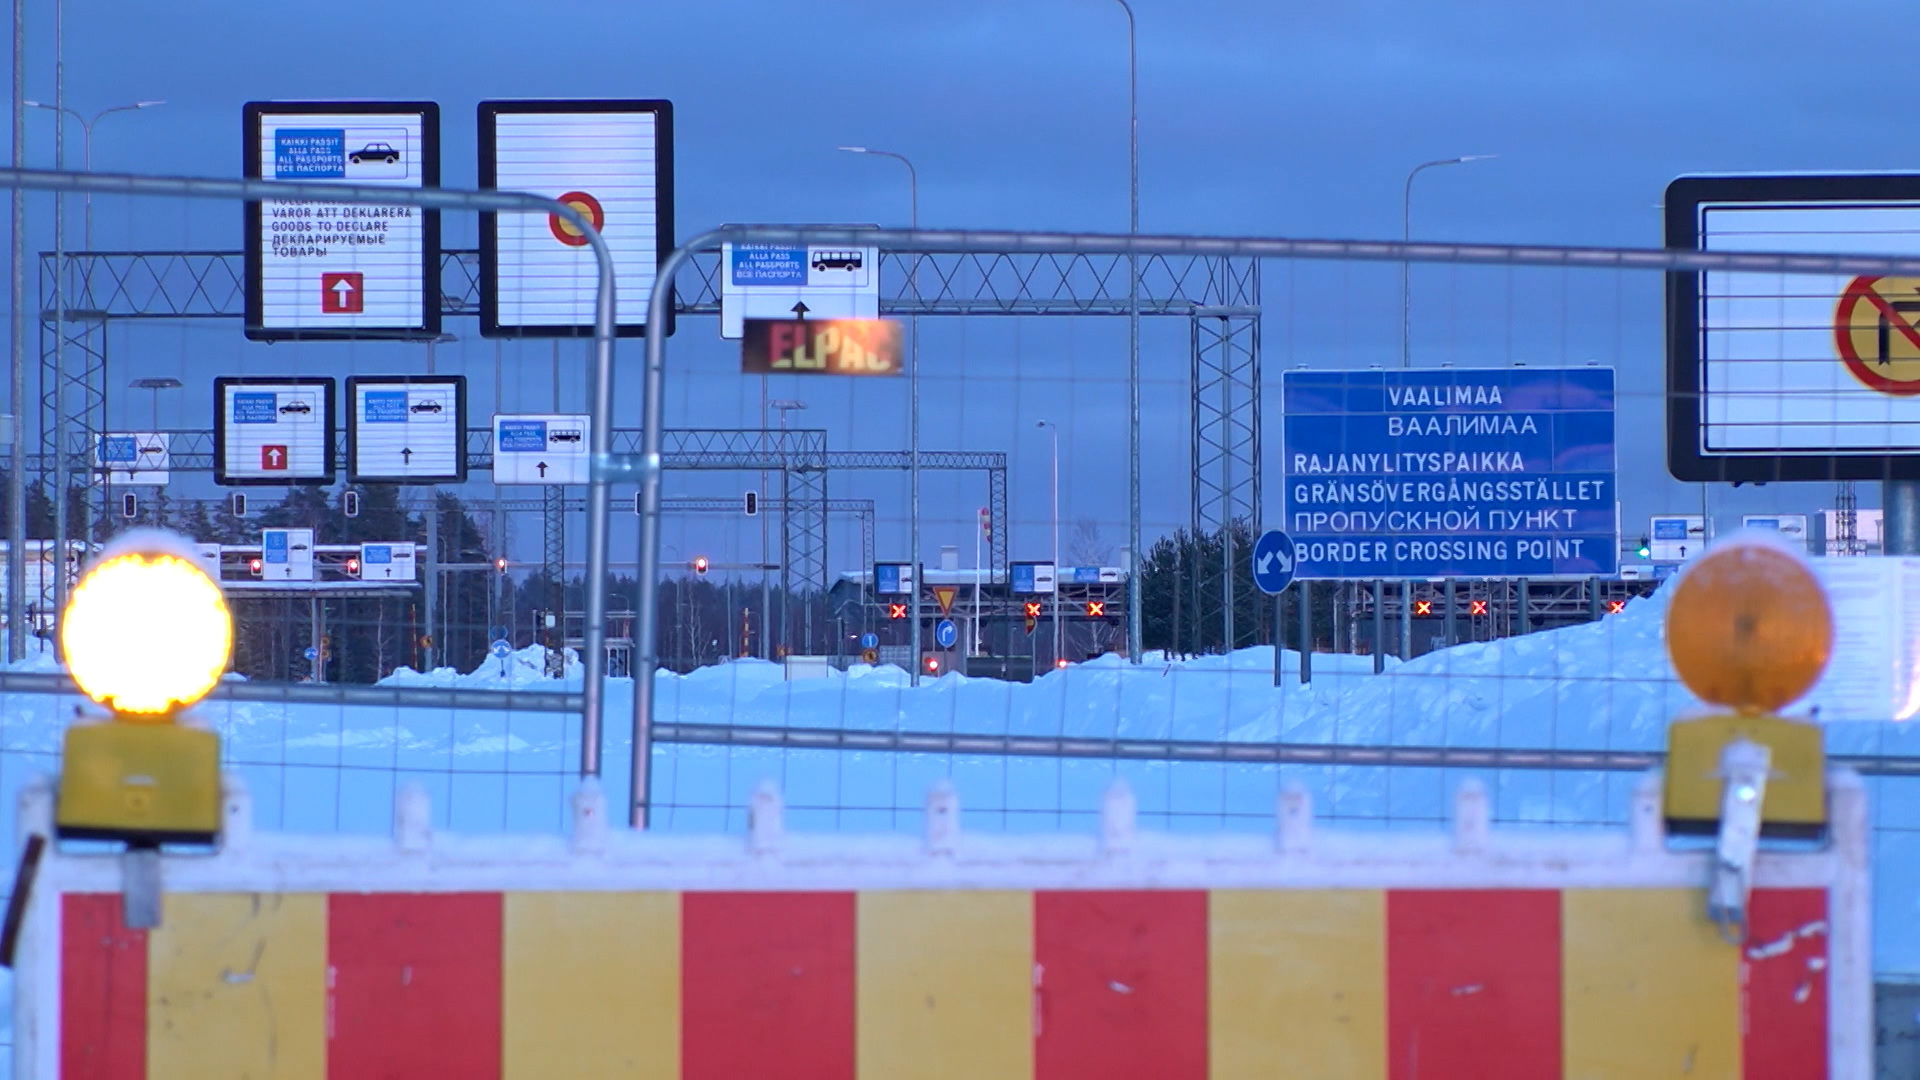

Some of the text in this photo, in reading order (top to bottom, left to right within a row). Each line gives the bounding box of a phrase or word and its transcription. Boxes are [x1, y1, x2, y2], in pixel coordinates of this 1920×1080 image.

[279, 155, 342, 163] ALL PASSPORTS
[272, 207, 412, 218] VAROR ATT DEKLARERA
[272, 221, 388, 231] GOODS TO DECLARE
[272, 247, 327, 257] ТОВАРЫ
[1388, 385, 1503, 406] VAALIMAA
[1388, 415, 1538, 437] ВААЛИМАА
[1294, 452, 1525, 474] RAJANYLITYSPAIKKA
[1294, 477, 1605, 504] GRÄNSÖVERGÅNGSSTÄLLET
[1294, 505, 1577, 532] ПРОПУСКНОЙ ПУНКТ
[1296, 539, 1585, 563] BORDER CROSSING POINT
